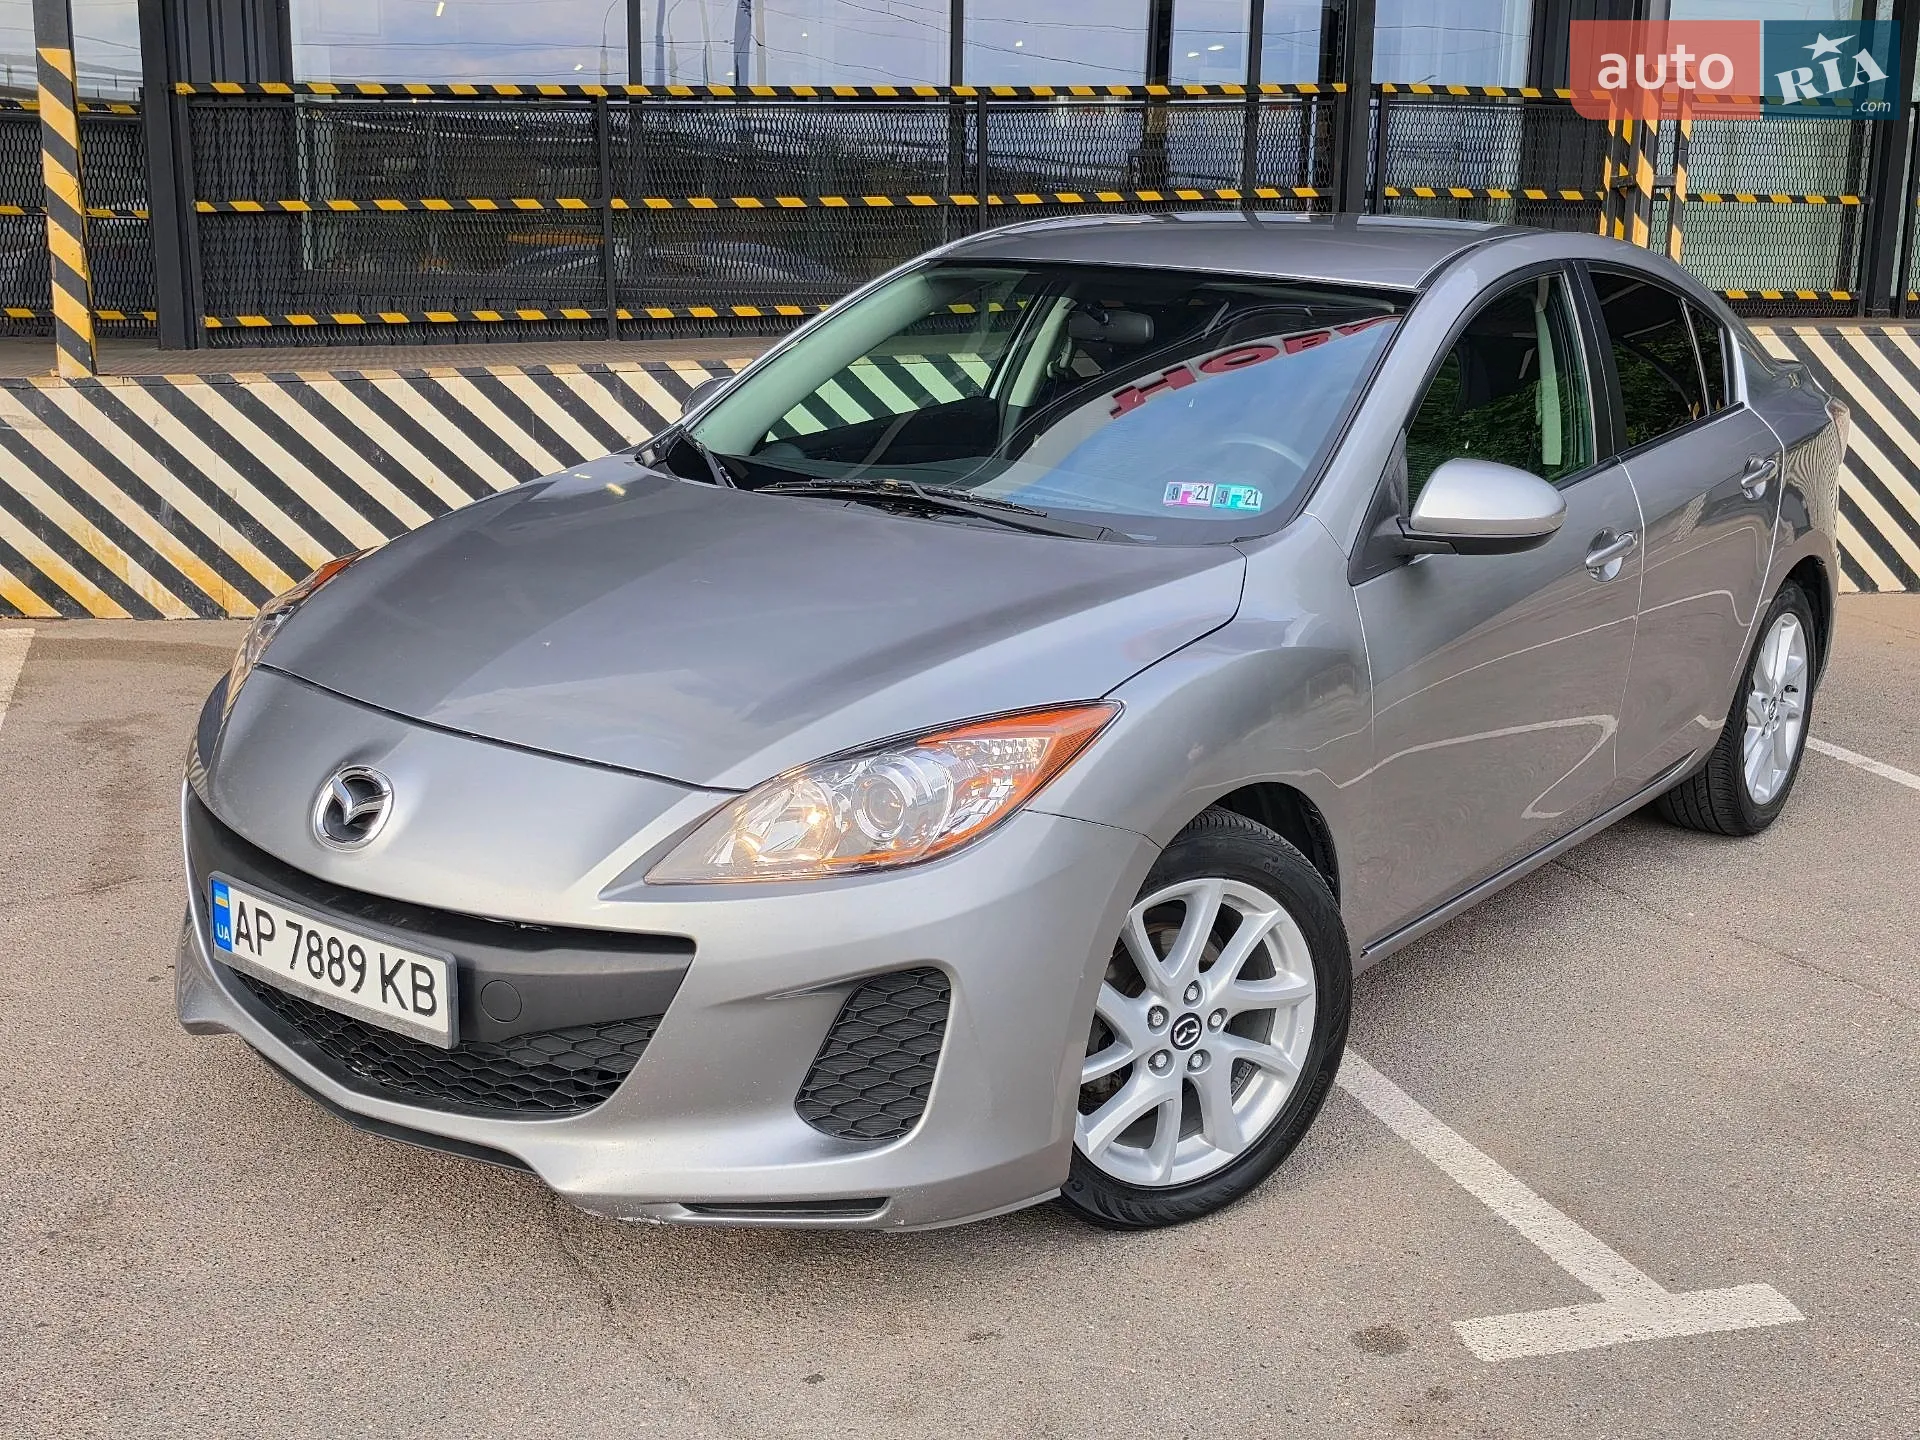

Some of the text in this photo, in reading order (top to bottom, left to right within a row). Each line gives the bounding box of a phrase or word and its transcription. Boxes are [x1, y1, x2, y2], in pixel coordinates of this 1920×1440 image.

[1195, 485, 1209, 501] 21
[1244, 489, 1258, 506] 21
[217, 924, 230, 943] UA
[235, 900, 438, 1018] AP 7889 KB
